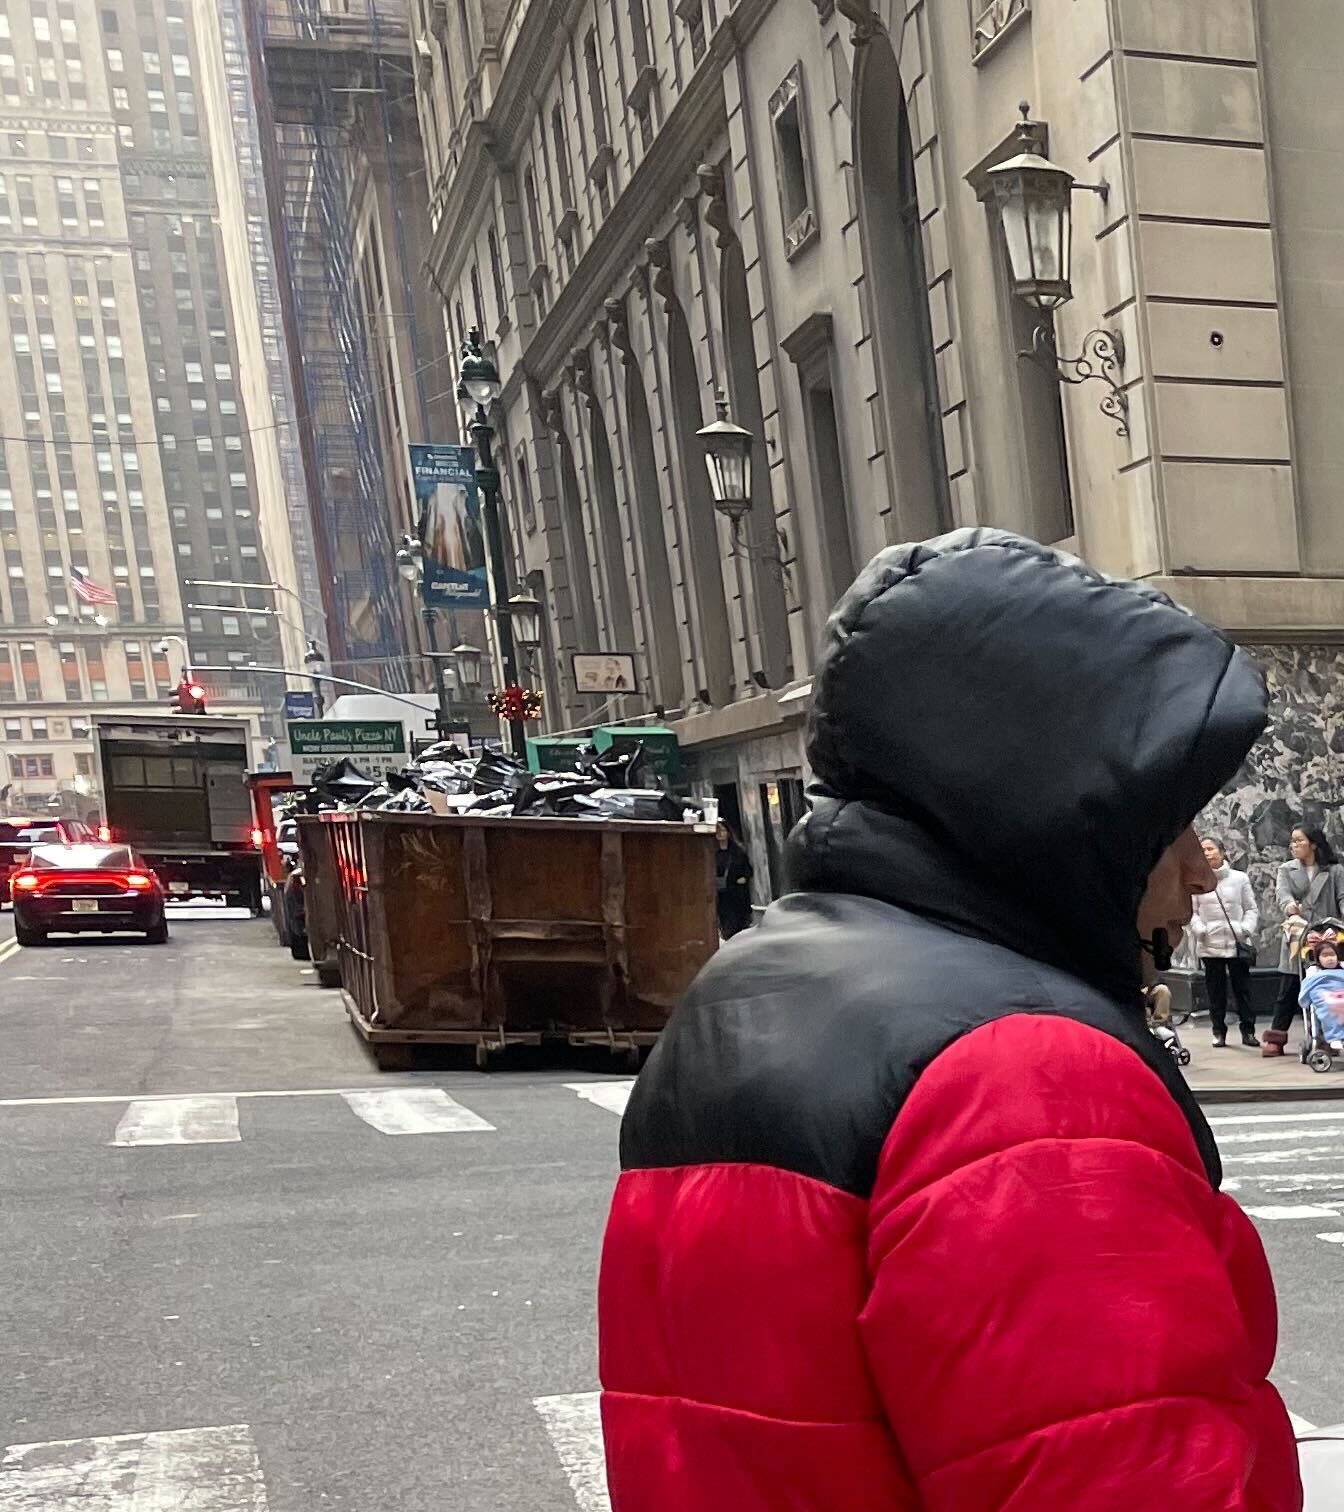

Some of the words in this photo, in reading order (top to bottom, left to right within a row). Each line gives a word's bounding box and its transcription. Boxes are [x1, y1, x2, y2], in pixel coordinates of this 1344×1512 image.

[415, 466, 473, 477] FINANCIAL
[294, 729, 321, 743] Uncle
[323, 728, 353, 743] Paul's
[354, 727, 383, 742] Pizza
[384, 726, 399, 742] NY
